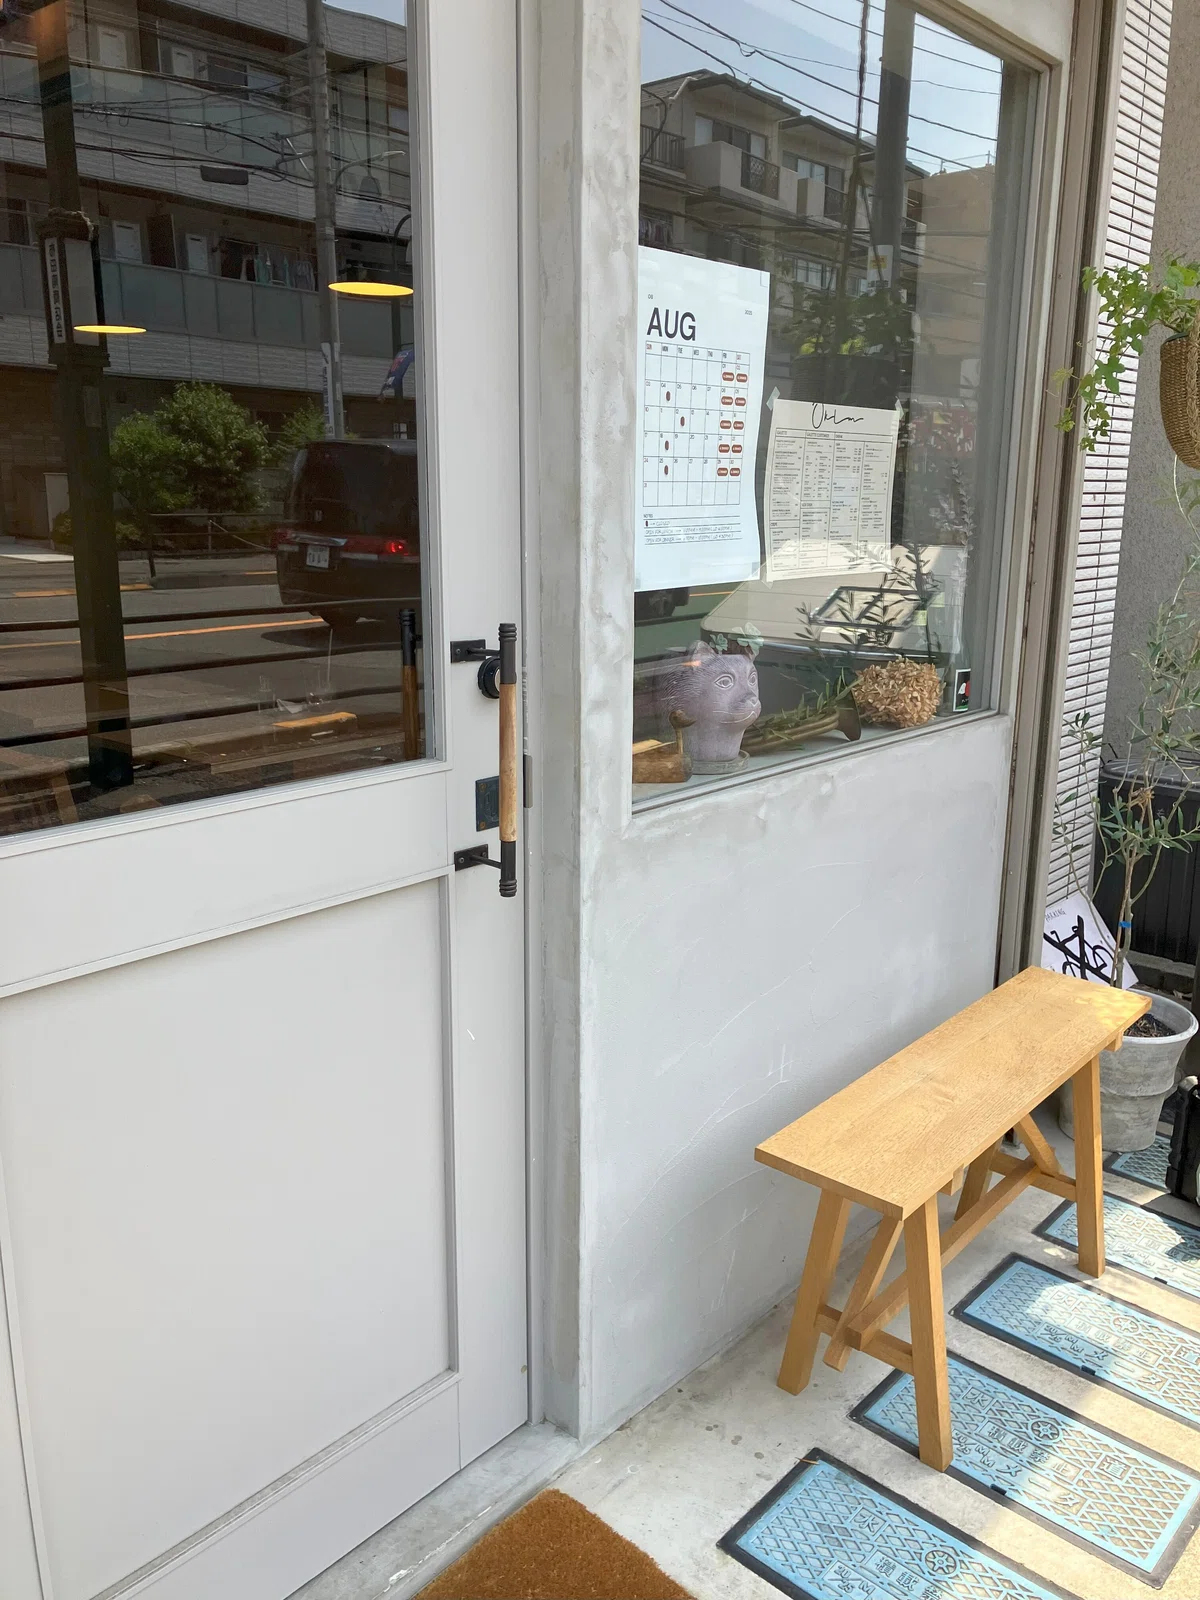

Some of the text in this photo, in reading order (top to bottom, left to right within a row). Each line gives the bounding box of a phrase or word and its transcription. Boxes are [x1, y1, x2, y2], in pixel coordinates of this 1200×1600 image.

[646, 306, 696, 341] AUG
[968, 1392, 1126, 1479] 水 道
[854, 1512, 880, 1533] 水
